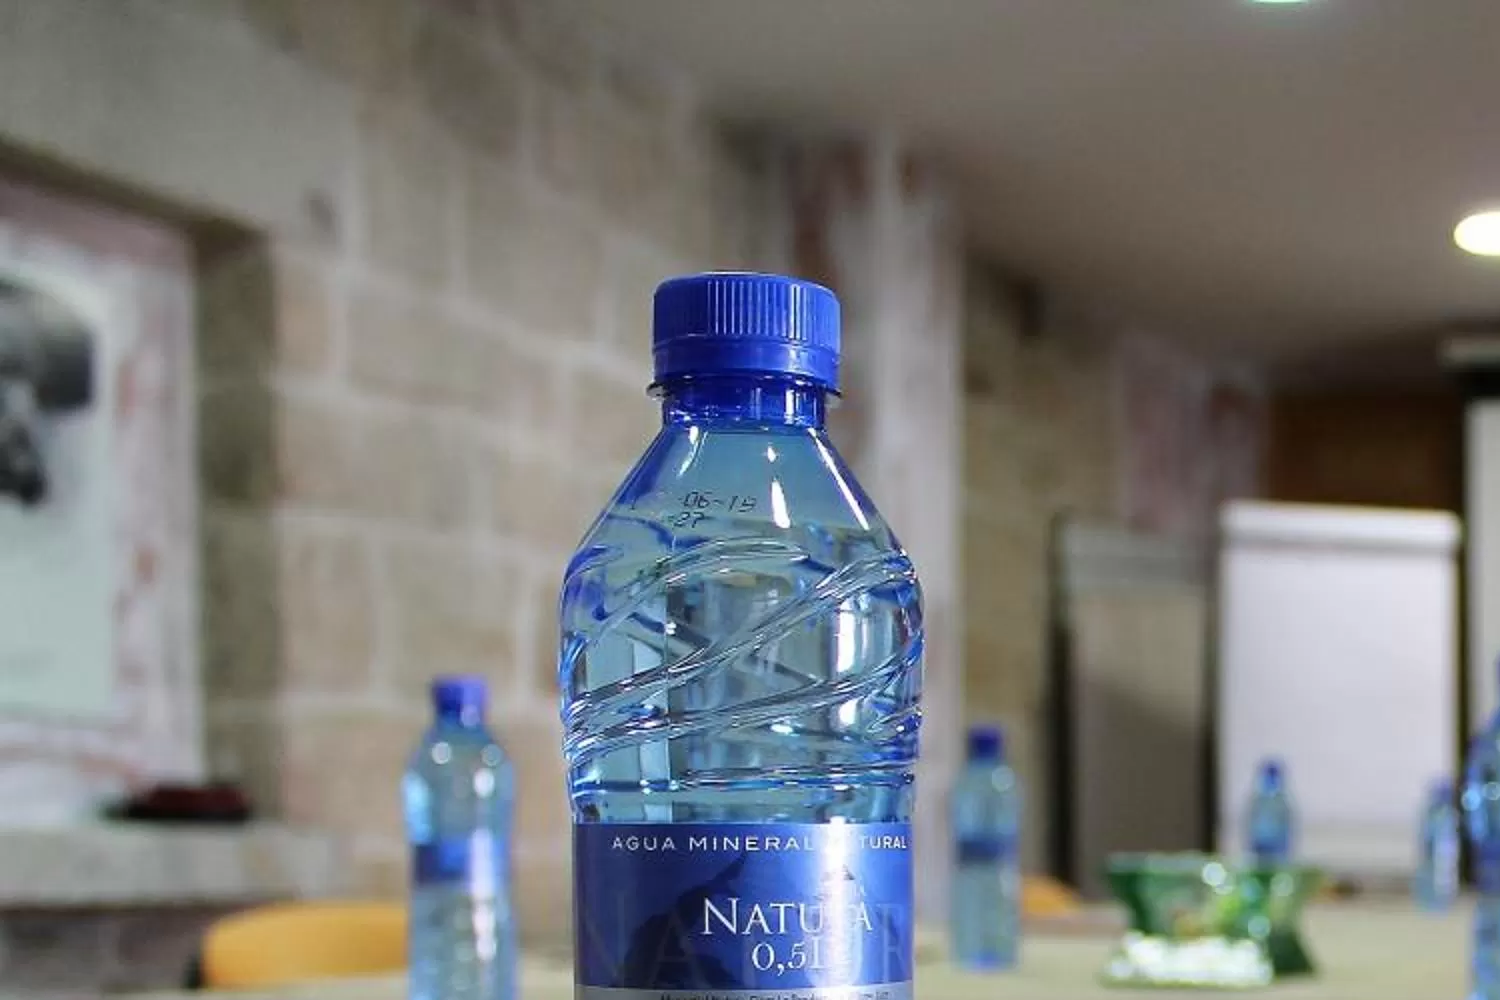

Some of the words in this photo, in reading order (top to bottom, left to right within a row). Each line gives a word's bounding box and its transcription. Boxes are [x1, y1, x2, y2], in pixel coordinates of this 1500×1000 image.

[611, 835, 676, 851] AGUA
[688, 835, 814, 851] MINERAL
[833, 834, 907, 850] TURAL
